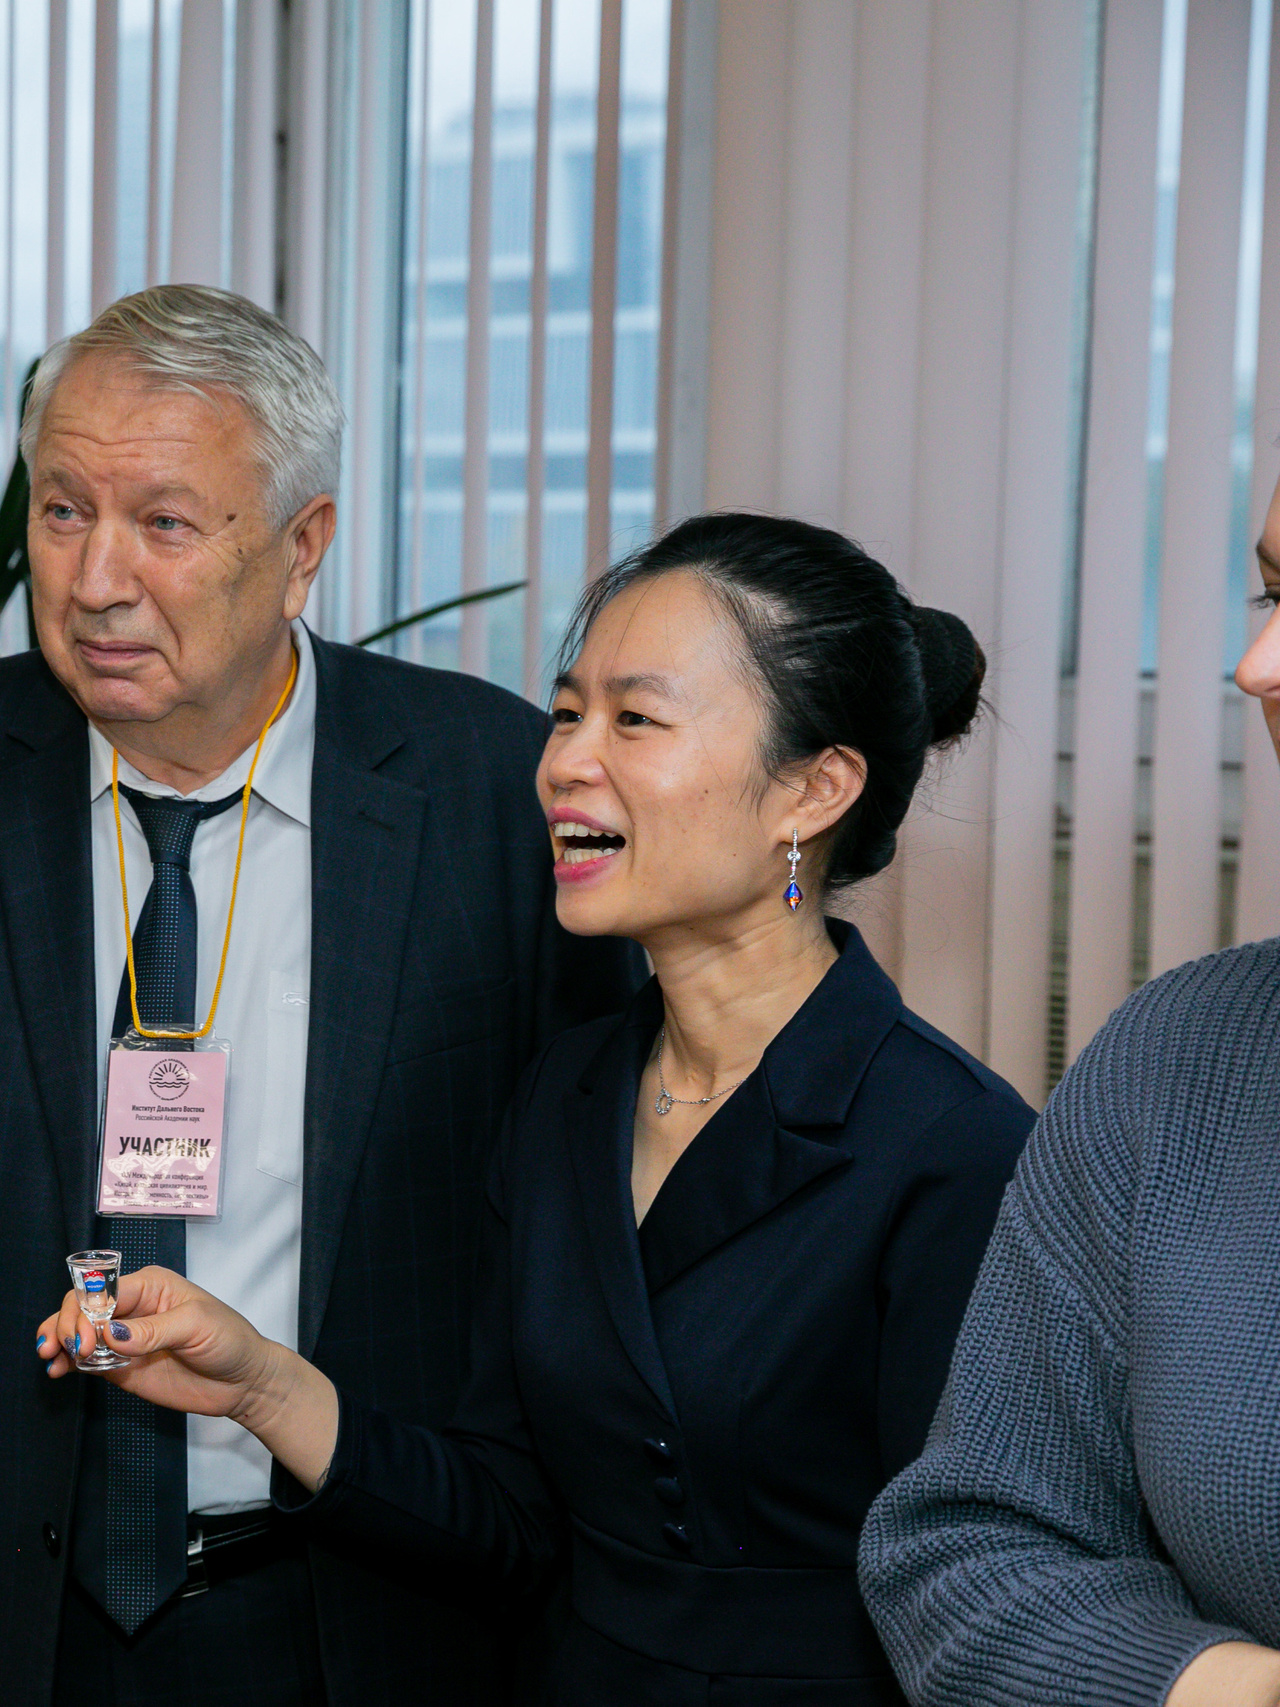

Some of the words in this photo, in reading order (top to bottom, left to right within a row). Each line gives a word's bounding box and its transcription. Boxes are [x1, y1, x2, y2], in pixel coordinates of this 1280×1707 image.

[131, 1104, 156, 1113] Институт
[156, 1105, 182, 1113] Дальнего
[183, 1105, 205, 1113] Востока
[135, 1113, 163, 1121] Российской
[164, 1114, 188, 1122] Академии
[118, 1136, 211, 1157] УЧАСТНИК
